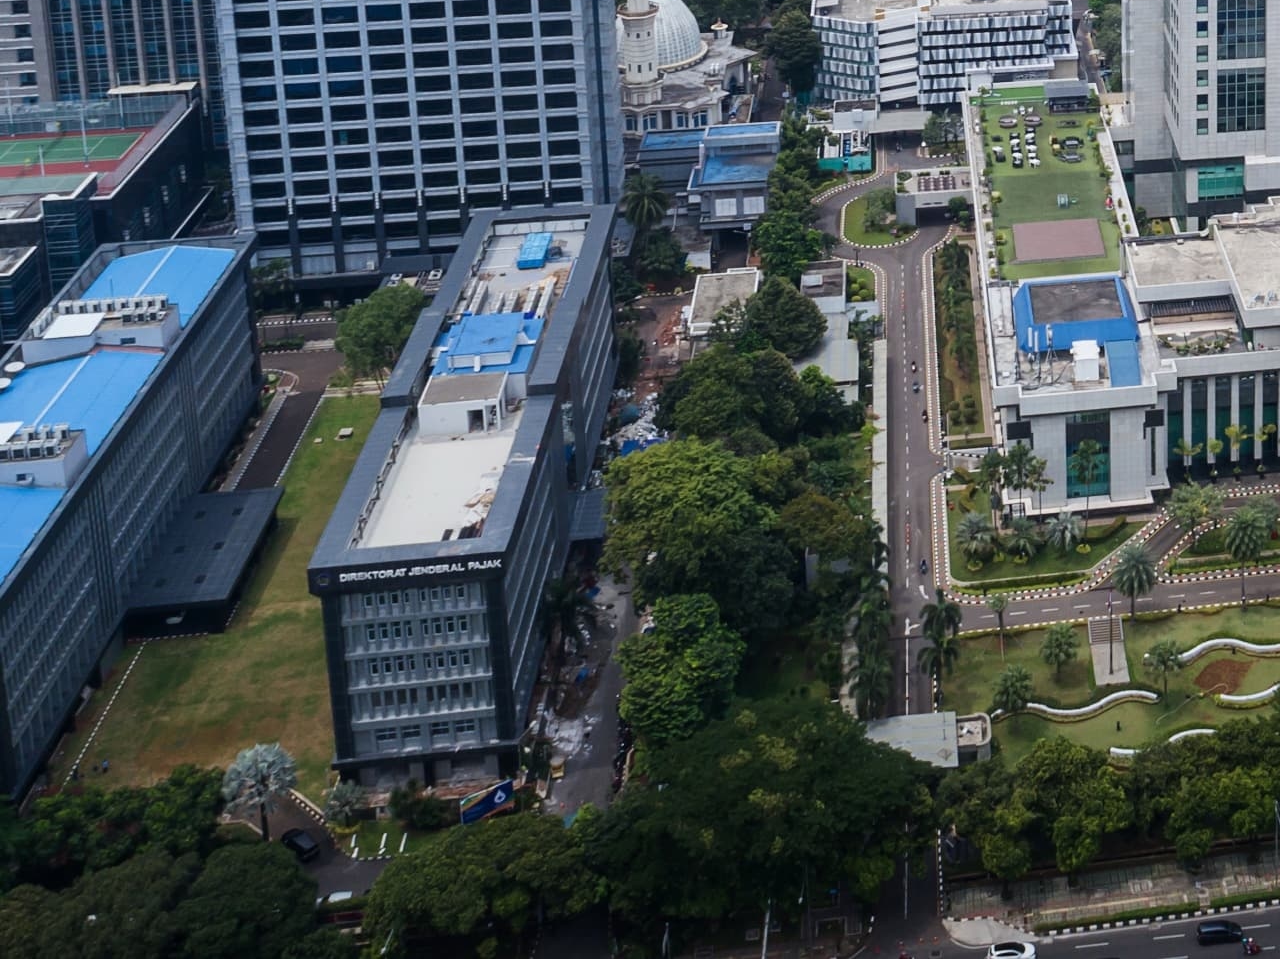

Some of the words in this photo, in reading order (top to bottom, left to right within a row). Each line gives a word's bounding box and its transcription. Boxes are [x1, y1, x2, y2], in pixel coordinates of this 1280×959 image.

[339, 567, 407, 583] DIREKTORAT
[408, 563, 465, 576] JENDERAL
[467, 559, 502, 570] PAJAK
